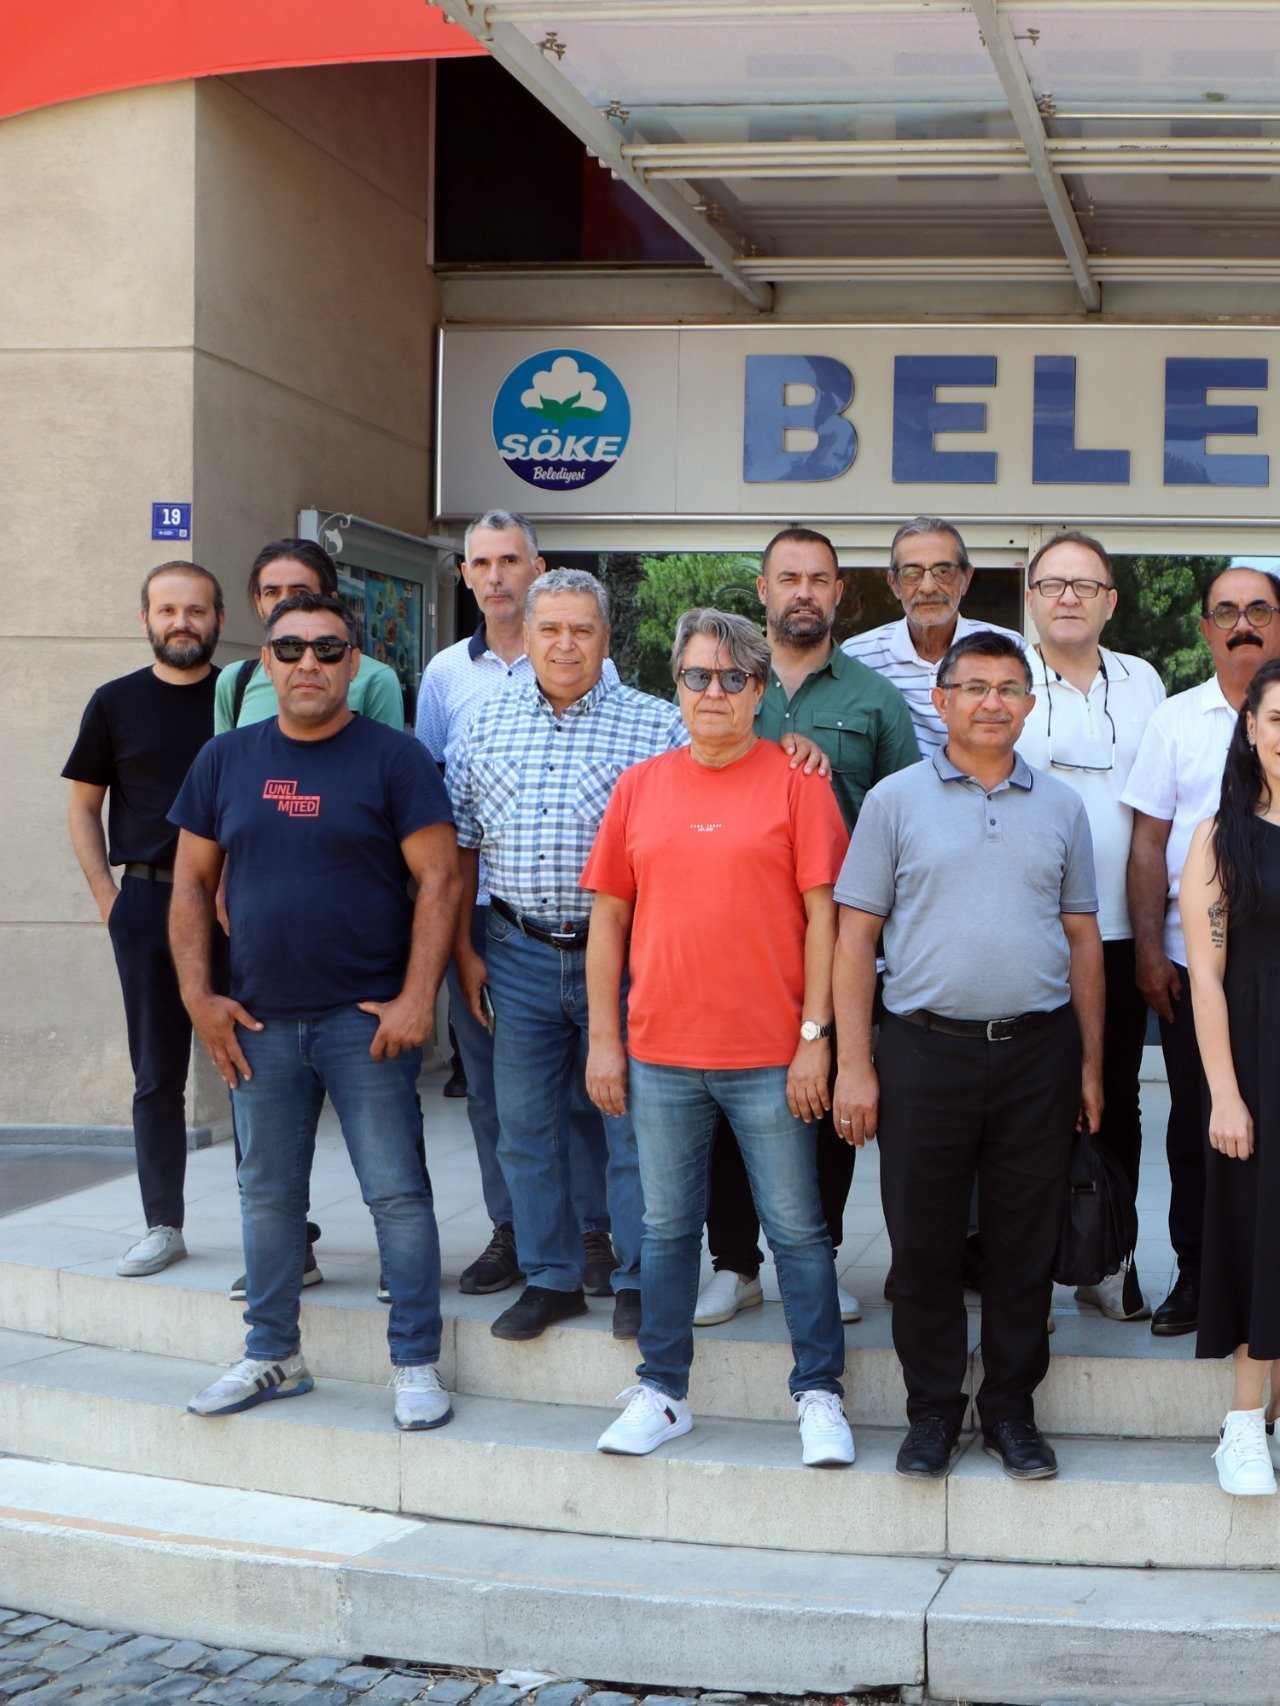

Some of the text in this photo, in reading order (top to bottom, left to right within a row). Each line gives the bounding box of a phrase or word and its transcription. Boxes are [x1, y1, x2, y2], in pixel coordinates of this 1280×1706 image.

[500, 428, 622, 461] SÖKE
[533, 466, 585, 483] Belediyesi
[163, 508, 181, 525] 19
